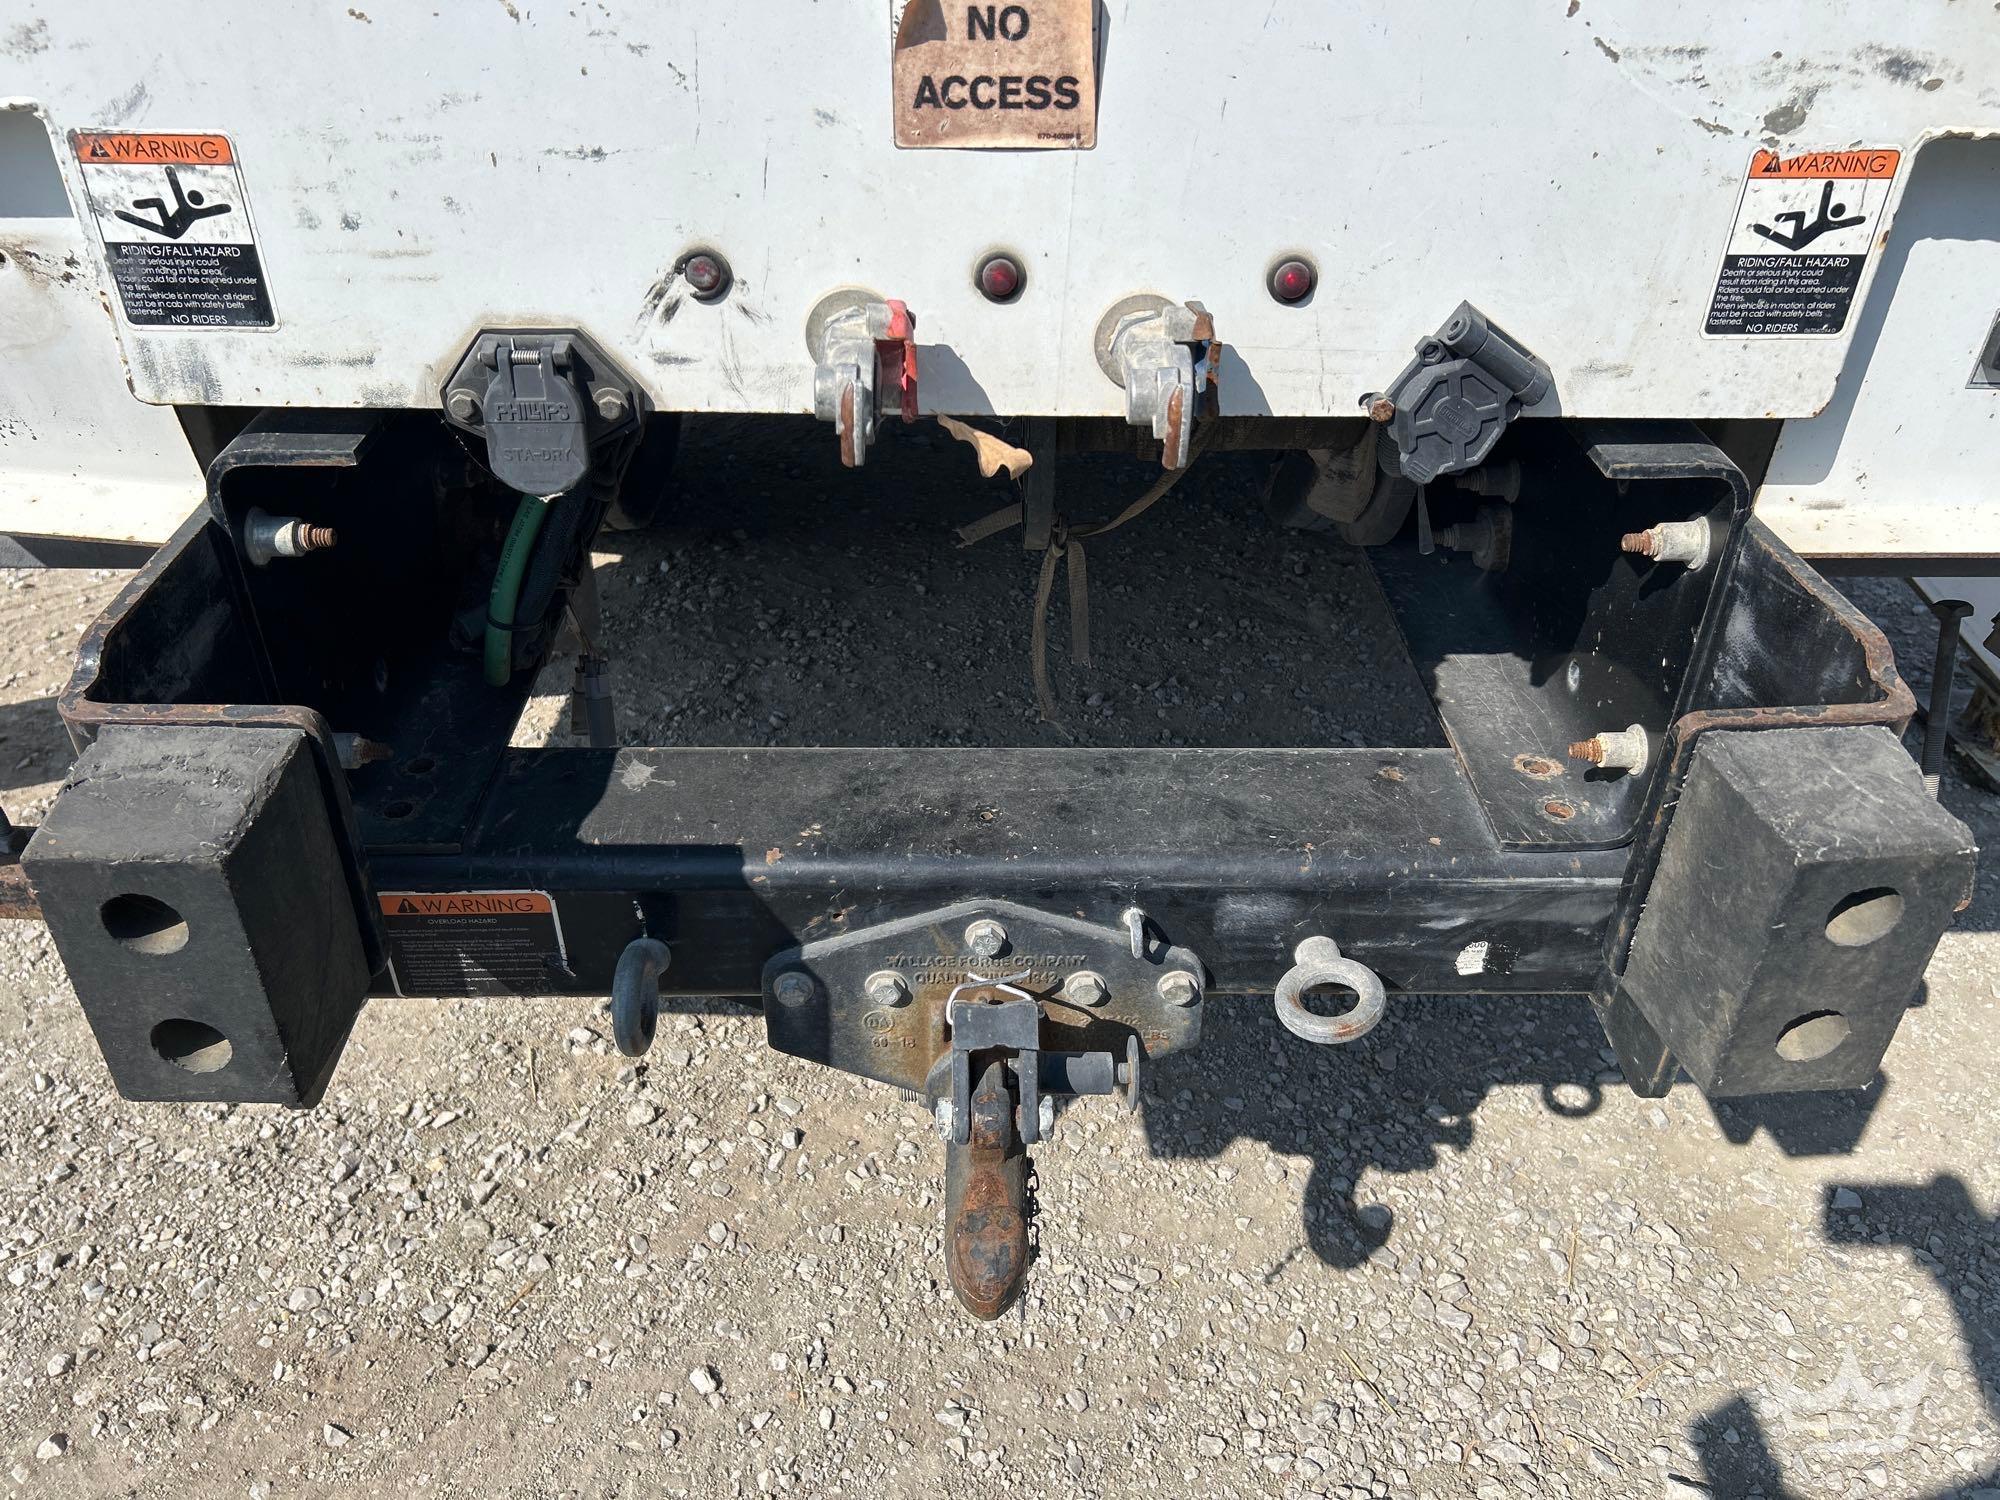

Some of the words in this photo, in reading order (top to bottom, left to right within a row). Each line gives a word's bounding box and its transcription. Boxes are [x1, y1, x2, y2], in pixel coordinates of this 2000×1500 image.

[967, 5, 1030, 41] NO
[913, 75, 1080, 110] ACCESS
[111, 139, 220, 159] WARNING
[1787, 155, 1887, 174] WARNING
[121, 245, 192, 256] RIDING/FALL
[194, 246, 241, 257] HAZARD
[174, 258, 195, 267] injury
[1737, 257, 1802, 268] RIDING/FALL
[1805, 257, 1850, 267] HAZARD
[178, 267, 187, 275] in
[187, 267, 200, 275] this
[1722, 269, 1746, 277] Death
[1755, 269, 1781, 277] serious
[1781, 269, 1801, 278] injury
[201, 276, 232, 284] crushed
[234, 277, 257, 285] under
[1758, 279, 1779, 287] riding
[1718, 286, 1739, 294] Riders
[1763, 286, 1774, 294] fall
[1784, 286, 1794, 294] be
[1796, 286, 1826, 294] crushed
[148, 292, 176, 300] vehicle
[177, 292, 183, 300] is
[183, 292, 191, 300] in
[223, 292, 233, 300] all
[201, 301, 225, 309] safety
[1782, 310, 1804, 318] safety
[171, 315, 190, 324] NO
[191, 315, 228, 325] RIDERS
[1709, 318, 1743, 326] fastened.
[1745, 324, 1763, 333] NO
[1765, 324, 1799, 333] RIDERS
[494, 402, 570, 422] PHILLIPS
[503, 448, 573, 463] STA-DRY
[421, 898, 534, 913] WARNING
[885, 955, 956, 968] WALLACE
[959, 955, 1011, 968] FORGE
[1013, 955, 1088, 968] COMPANY
